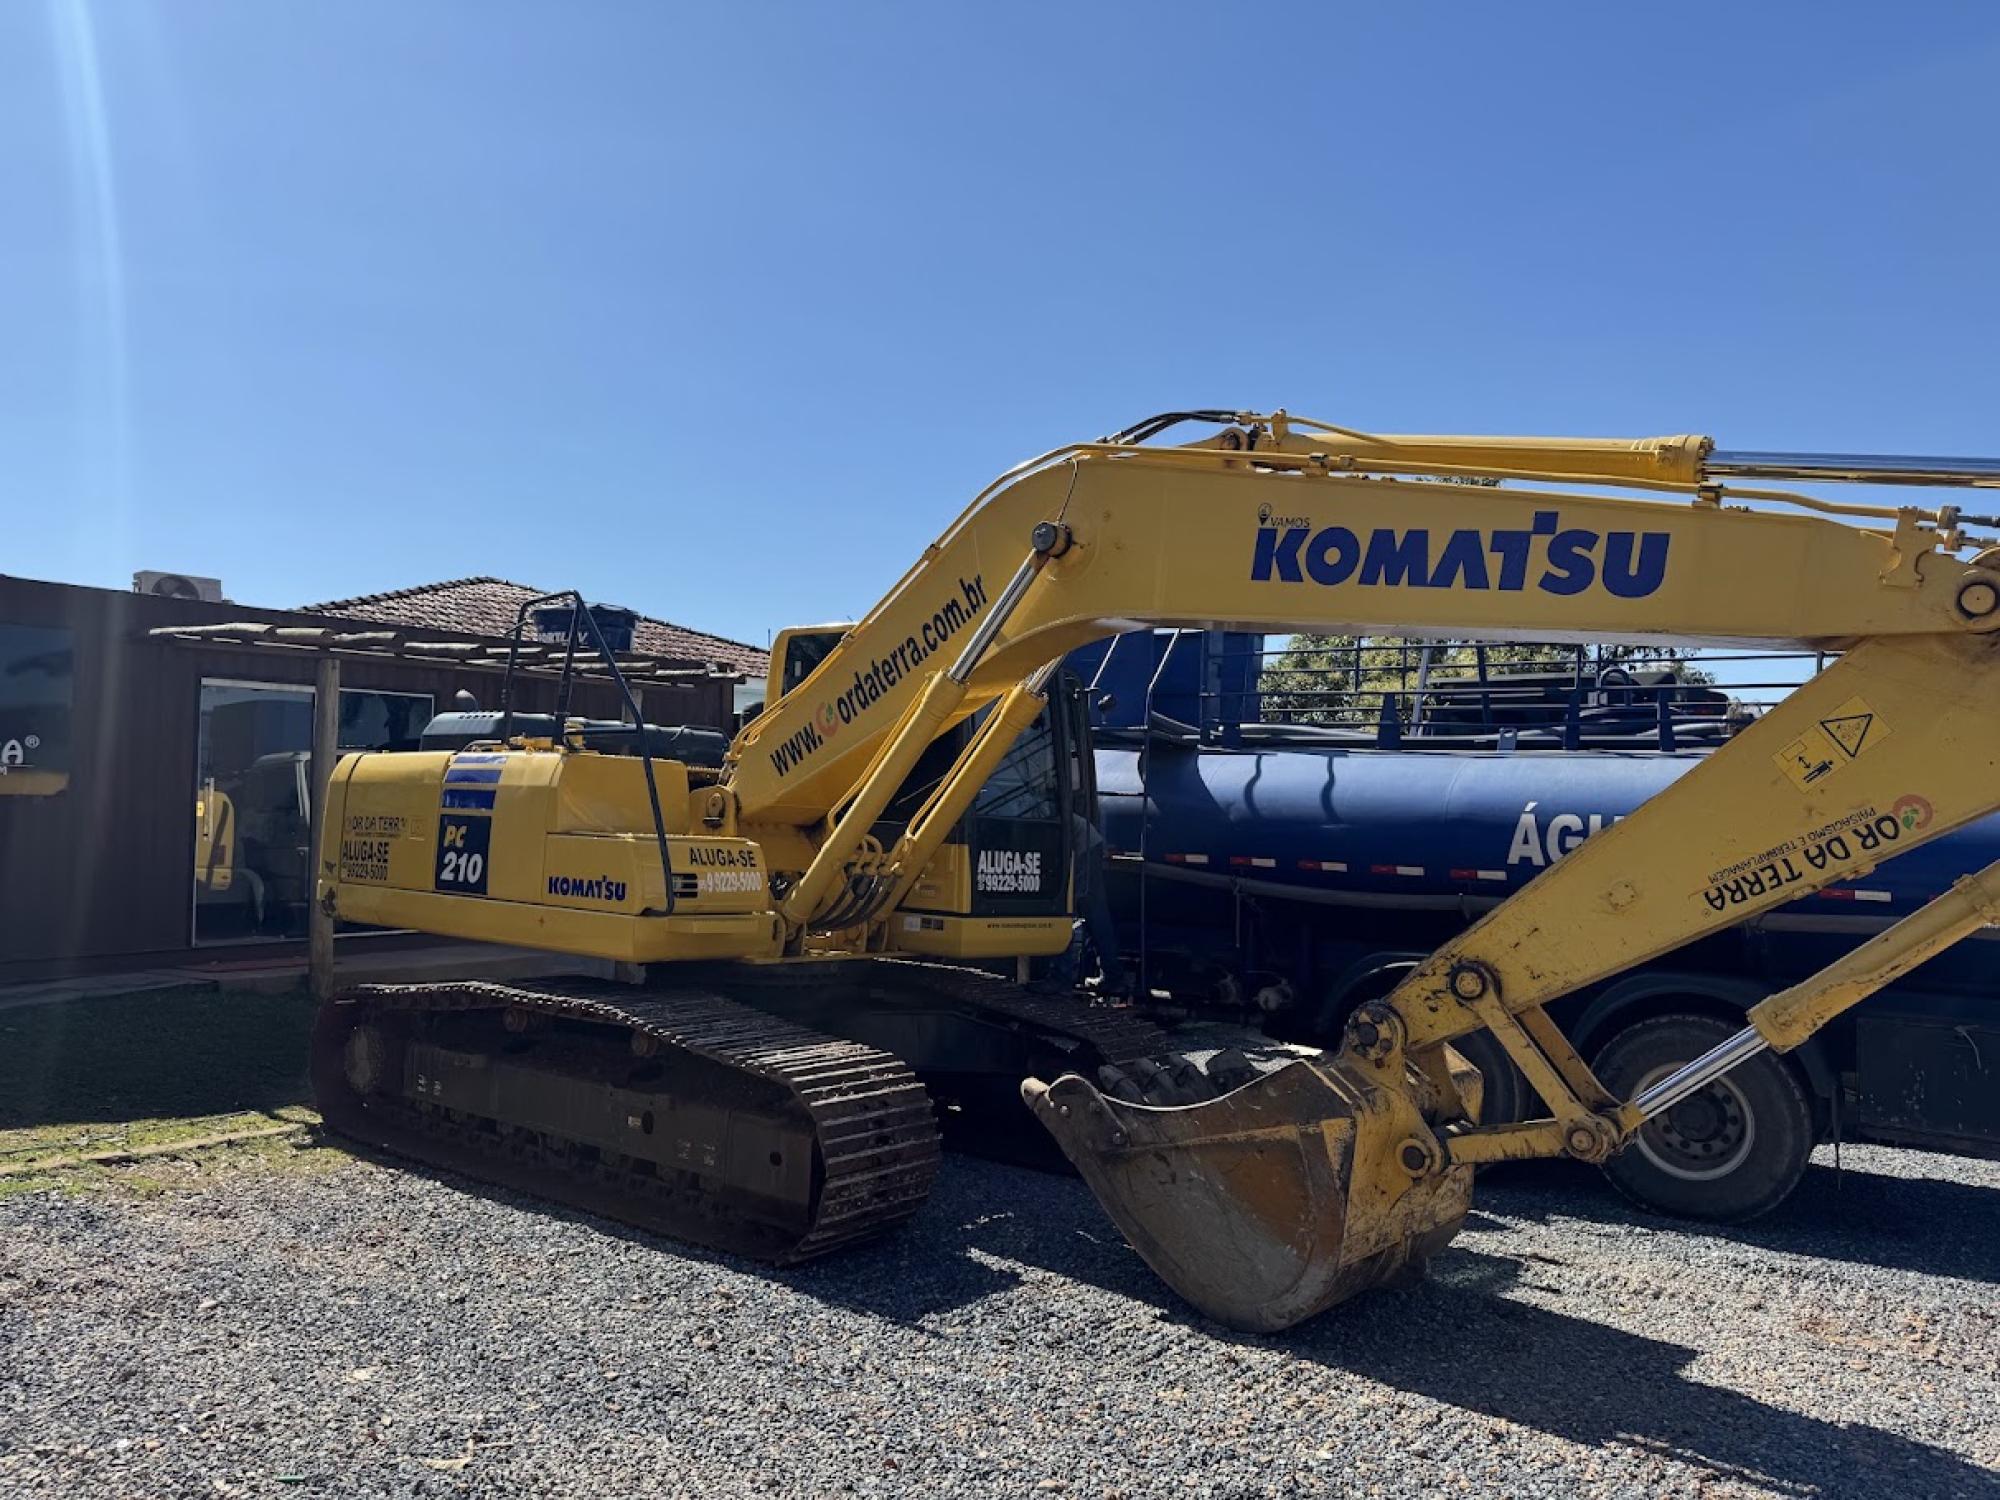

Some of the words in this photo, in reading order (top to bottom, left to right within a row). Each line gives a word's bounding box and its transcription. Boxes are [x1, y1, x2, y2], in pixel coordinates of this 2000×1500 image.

[1270, 516, 1311, 528] VAMOS
[1250, 511, 1671, 598] KOMATSU
[443, 825, 467, 848] PC
[1507, 801, 1624, 866] ÁG
[341, 840, 390, 863] ALUGA-SE
[689, 847, 757, 868] ALUGA-SE
[977, 849, 1041, 875] ALUGA-SE
[1804, 835, 1851, 870] DA
[440, 852, 483, 884] 210
[548, 875, 627, 901] KOMATSU
